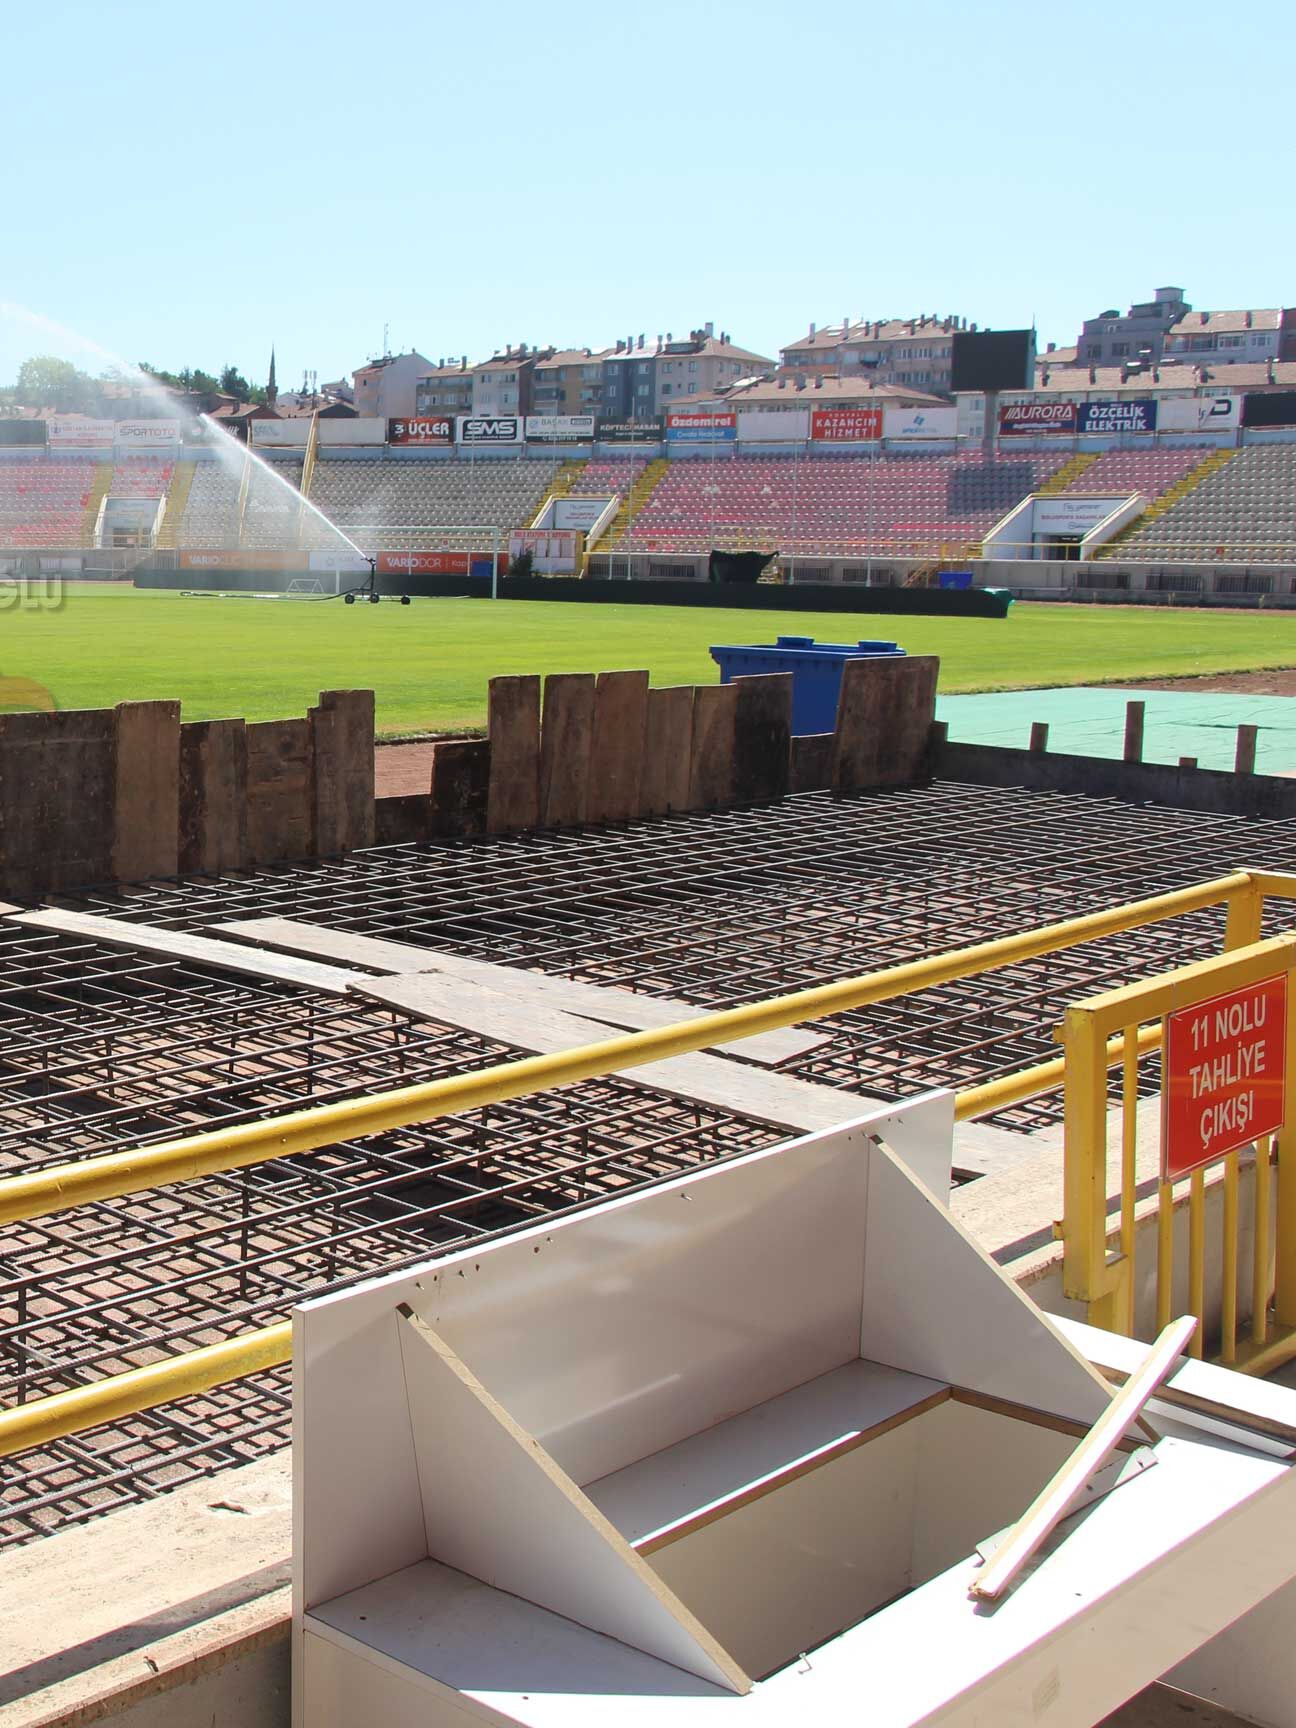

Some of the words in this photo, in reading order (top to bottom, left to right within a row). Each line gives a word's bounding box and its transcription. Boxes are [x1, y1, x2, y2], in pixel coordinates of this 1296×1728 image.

[1089, 404, 1145, 420] ÖZÇELİK
[408, 420, 449, 438] ÜÇLER
[464, 421, 515, 434] SMS
[824, 428, 868, 437] HİZMET
[1085, 417, 1147, 431] ELEKTRİK
[1192, 1015, 1208, 1050] 11
[1215, 994, 1266, 1043] NOLU
[1189, 1039, 1266, 1099] TAHLİYE
[1200, 1090, 1254, 1149] ÇIKIŞI
